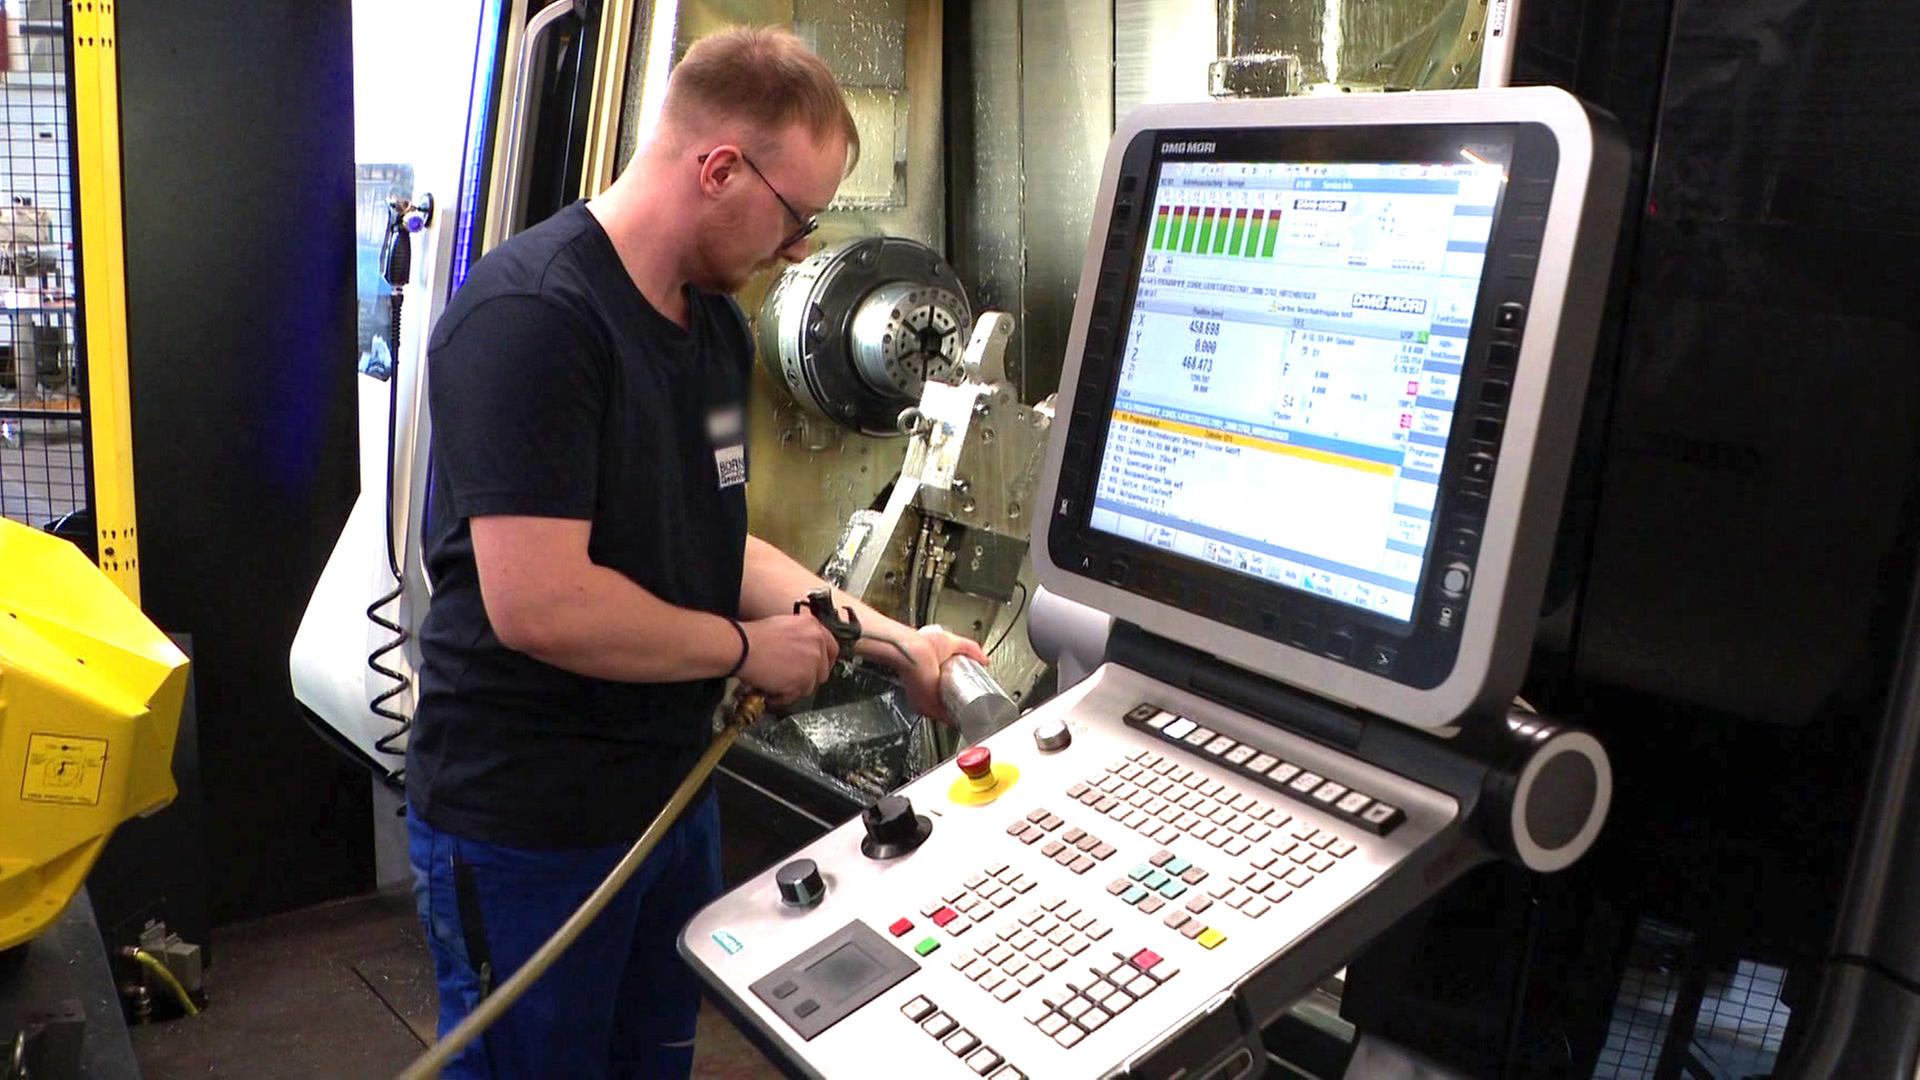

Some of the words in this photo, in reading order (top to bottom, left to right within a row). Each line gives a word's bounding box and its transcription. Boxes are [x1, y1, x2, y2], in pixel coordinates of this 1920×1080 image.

[1161, 142, 1186, 154] DMG
[1187, 142, 1216, 153] MORI
[1353, 294, 1386, 309] DMG
[1387, 297, 1425, 313] MORI
[1137, 312, 1146, 326] X
[1133, 328, 1143, 344] Y
